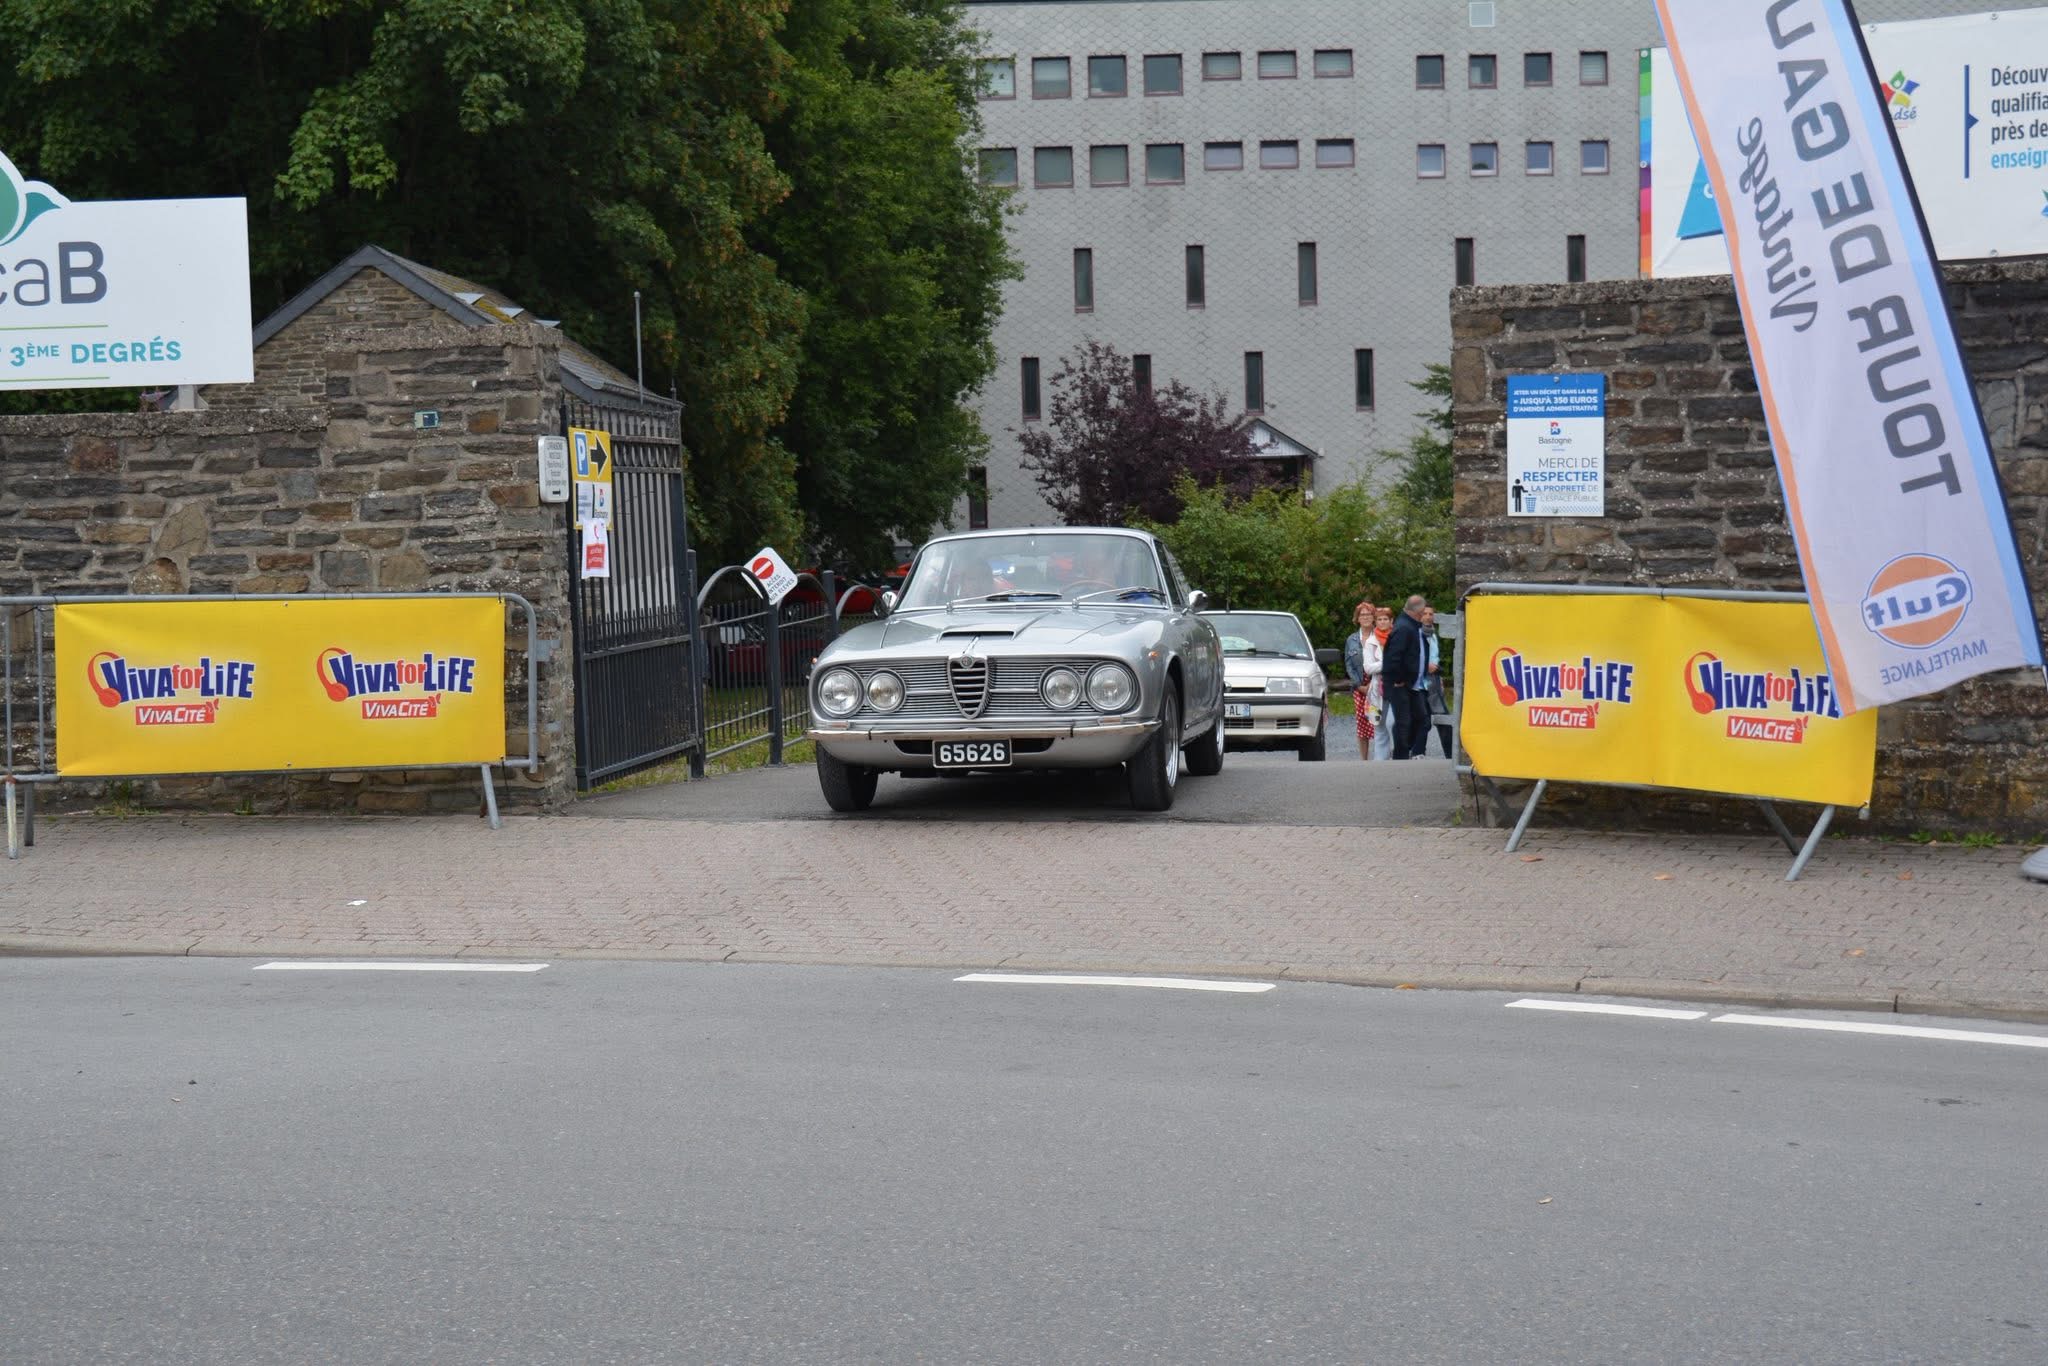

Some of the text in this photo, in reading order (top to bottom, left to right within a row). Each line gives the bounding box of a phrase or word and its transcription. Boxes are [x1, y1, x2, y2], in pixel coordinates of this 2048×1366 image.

[1991, 120, 2025, 145] près
[71, 336, 181, 365] DEGRÉS
[1569, 396, 1598, 404] EUROS
[1538, 437, 1573, 446] Bastogne
[1538, 457, 1598, 468] MERCI DE
[1523, 471, 1598, 482] RESPECTER
[940, 743, 1005, 763] 65626
